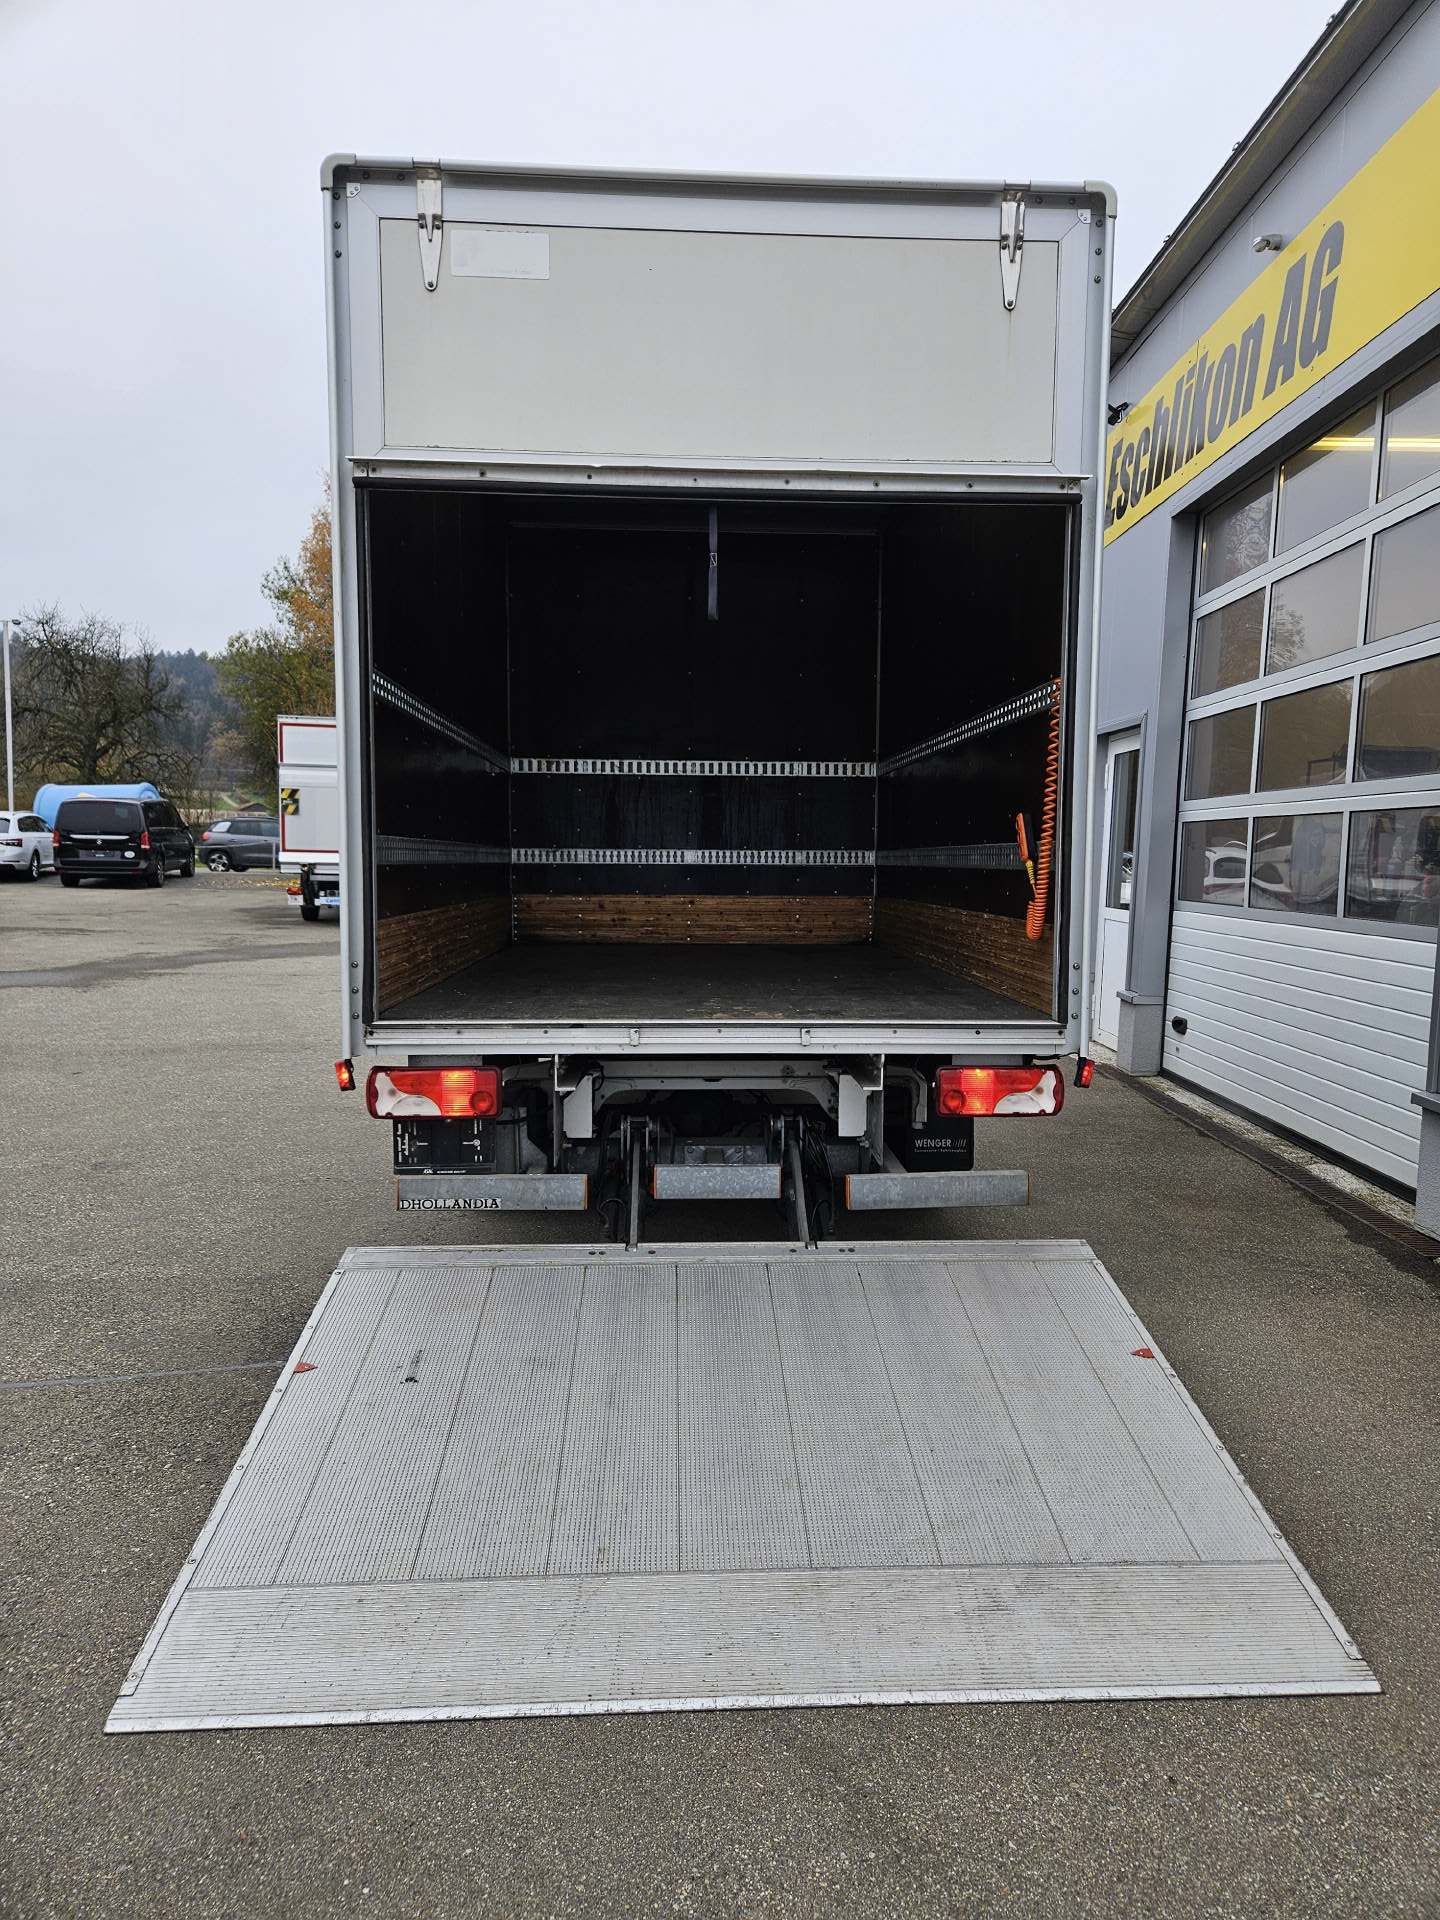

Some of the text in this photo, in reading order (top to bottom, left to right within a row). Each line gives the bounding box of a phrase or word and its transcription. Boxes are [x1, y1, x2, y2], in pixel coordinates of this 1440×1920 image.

[1103, 219, 1345, 528] Eschlikon AG
[914, 1138, 951, 1148] WENGER
[400, 1198, 500, 1210] DHOLLANDIA
